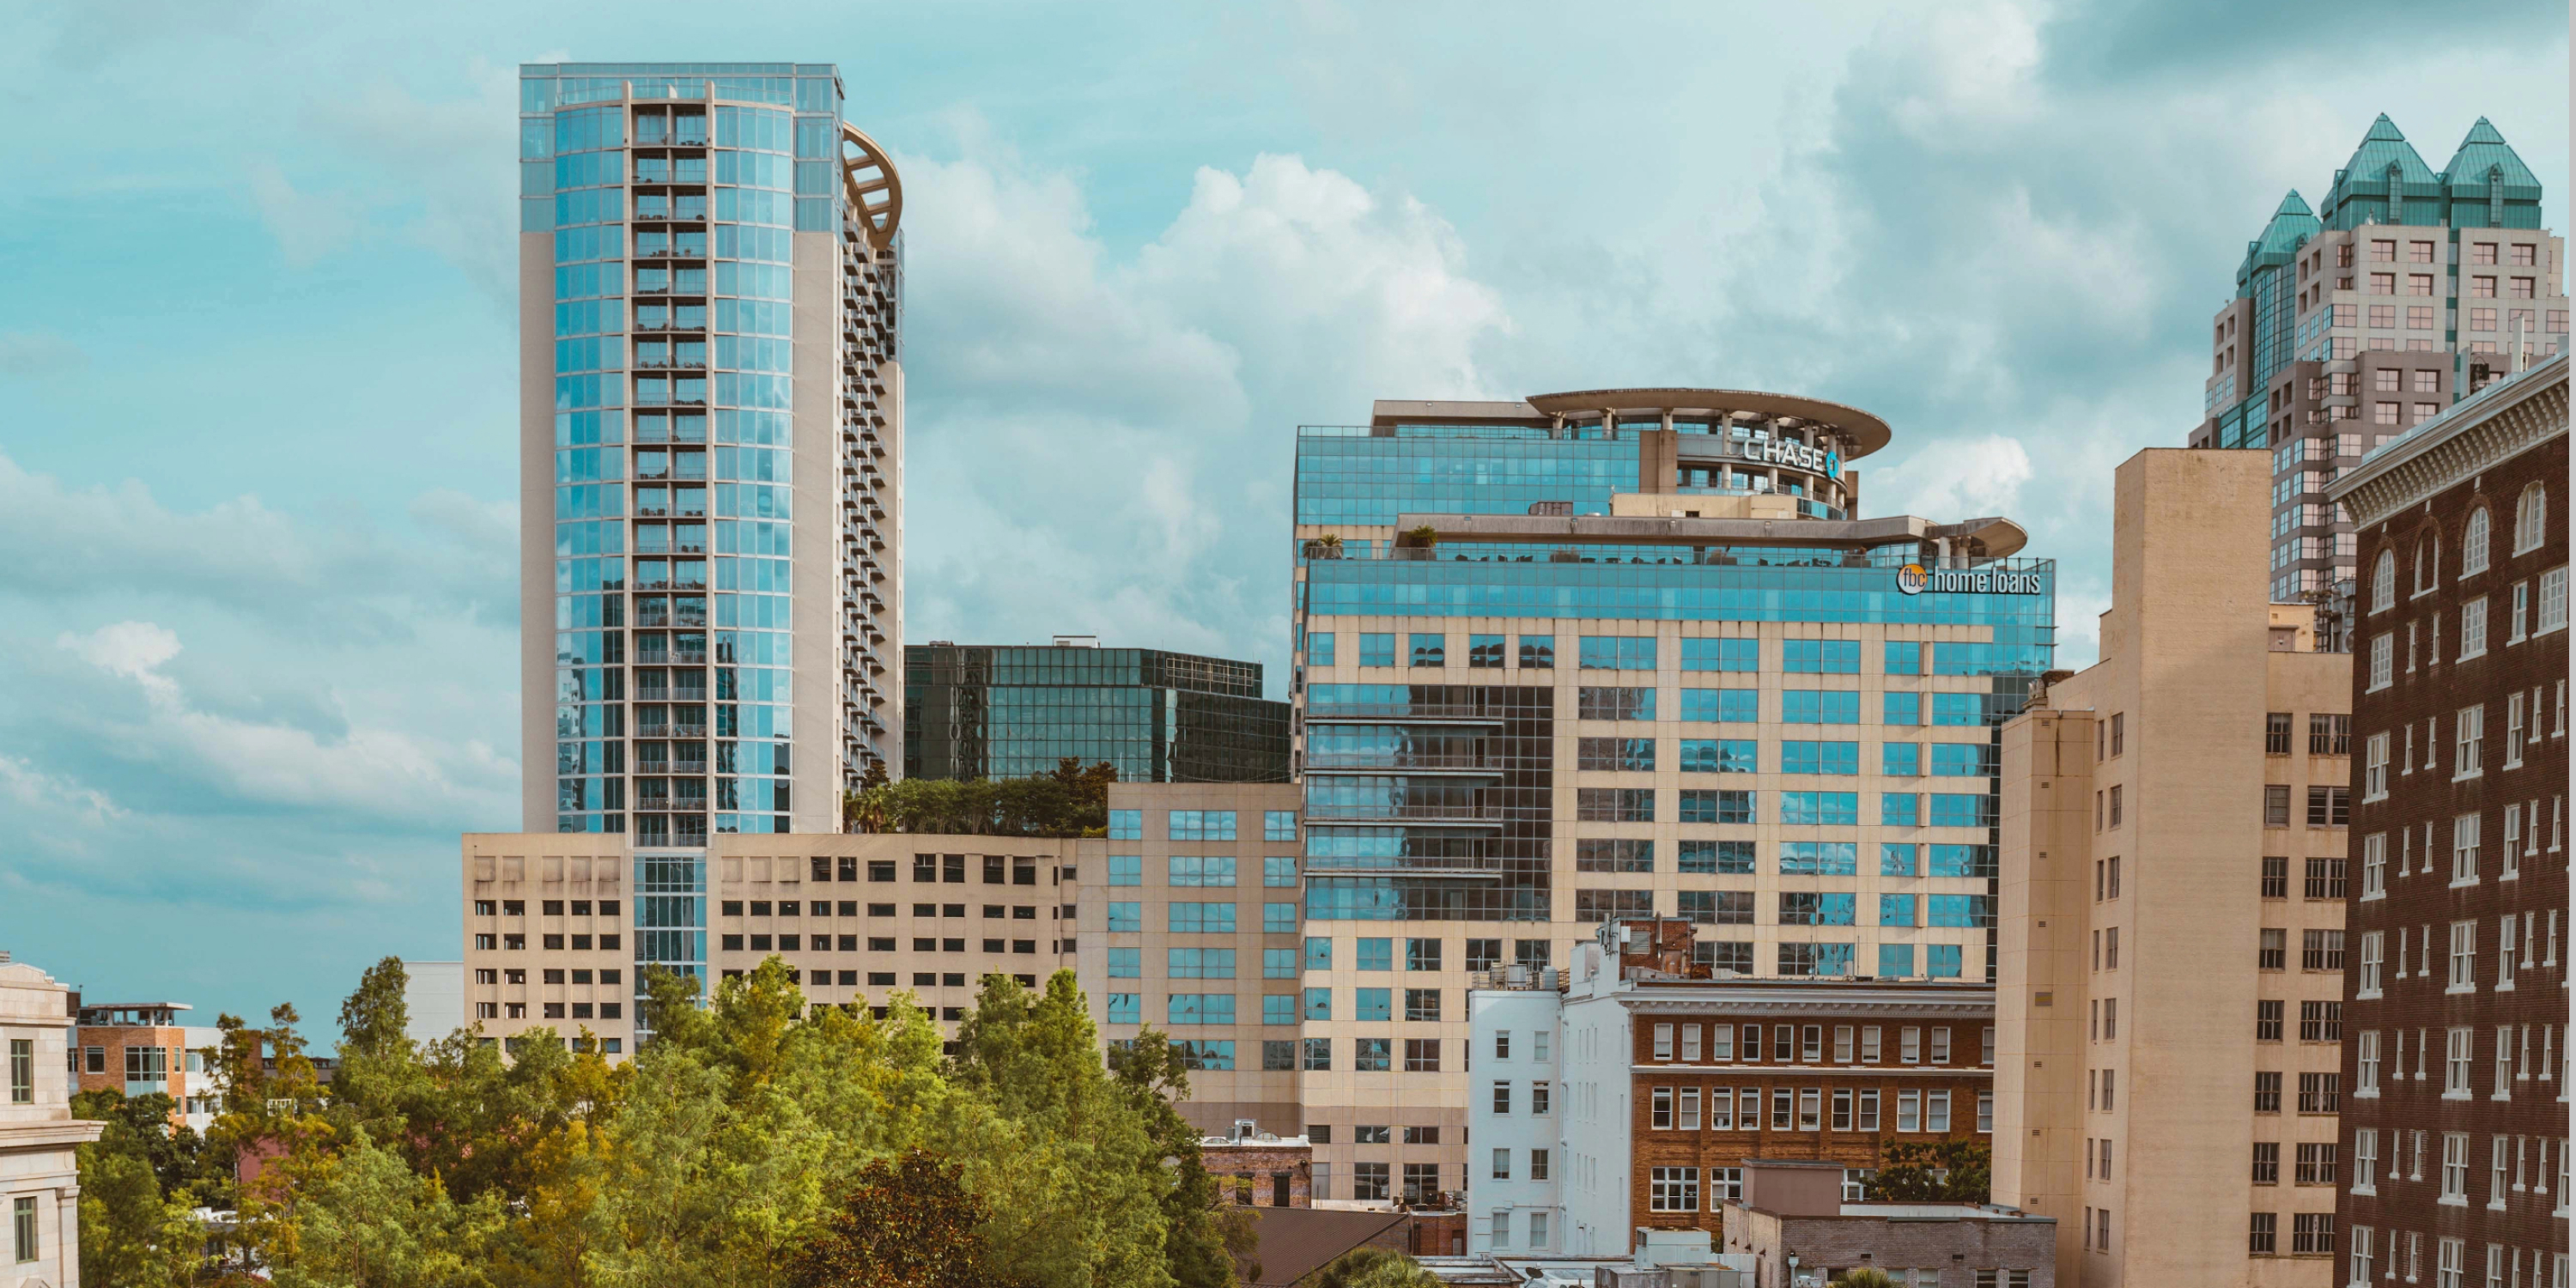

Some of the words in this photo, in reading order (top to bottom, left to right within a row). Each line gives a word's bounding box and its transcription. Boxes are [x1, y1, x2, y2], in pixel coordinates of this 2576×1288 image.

[1743, 437, 1824, 471] CHASE
[1903, 568, 1926, 587] fbc
[1935, 566, 1987, 592] home
[1991, 567, 2041, 593] loans
